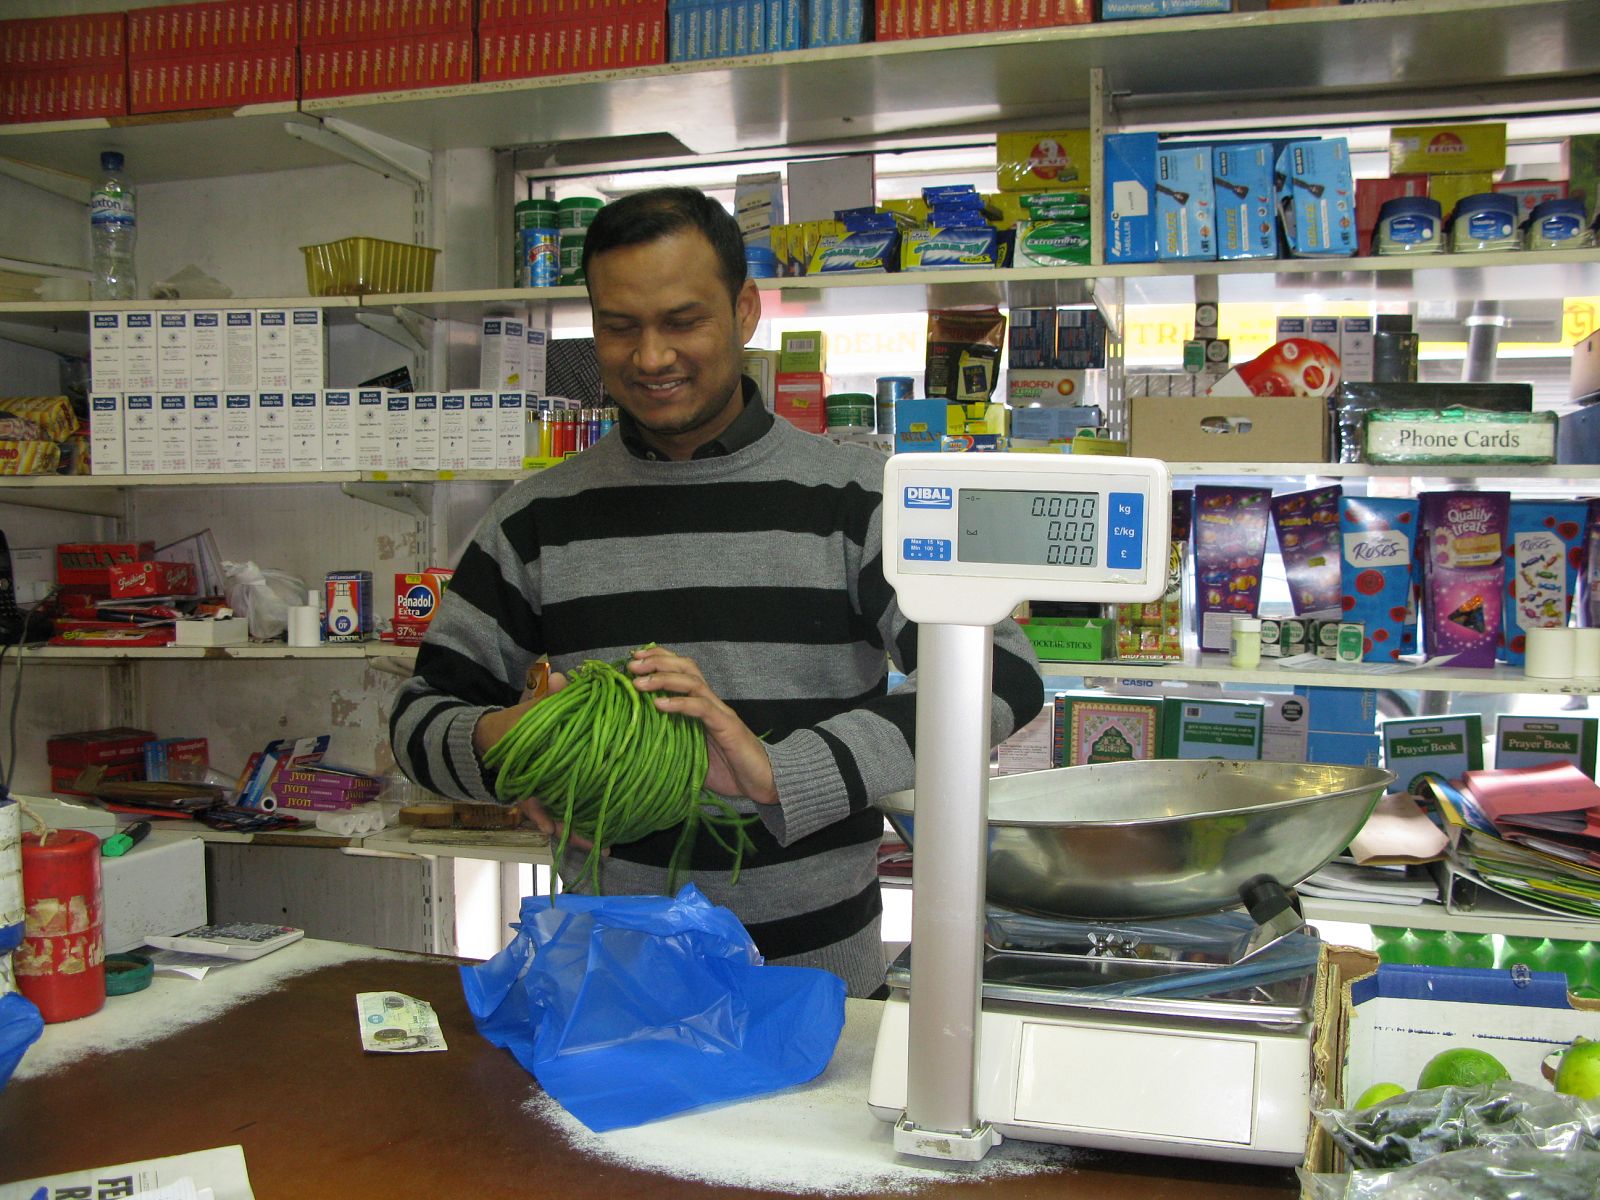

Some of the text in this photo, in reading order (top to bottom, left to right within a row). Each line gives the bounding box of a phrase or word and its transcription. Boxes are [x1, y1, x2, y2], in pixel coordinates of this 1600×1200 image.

[1010, 380, 1054, 389] NUROFEN
[1400, 429, 1520, 448] Phone Cards
[908, 488, 950, 500] DIBAL
[1032, 497, 1095, 518] 0.000
[1119, 504, 1131, 515] kg
[1447, 508, 1493, 523] Quality
[1047, 521, 1094, 542] 0.00
[1114, 527, 1135, 537] £/kg
[1452, 520, 1488, 537] treats
[1047, 544, 1094, 565] 0.00
[1121, 550, 1127, 558] £
[118, 571, 147, 591] Smoking
[397, 594, 431, 608] Panadol
[399, 608, 420, 616] Extra
[397, 626, 417, 636] 37%
[1031, 639, 1092, 650] OCKTAIL STICKS
[1122, 678, 1154, 687] CASIO
[1396, 741, 1457, 754] Prayer Book
[1508, 739, 1572, 751] Prayer Book
[290, 771, 316, 782] JYOTI
[282, 784, 308, 794] JYOTI
[286, 797, 312, 808] JYOTI
